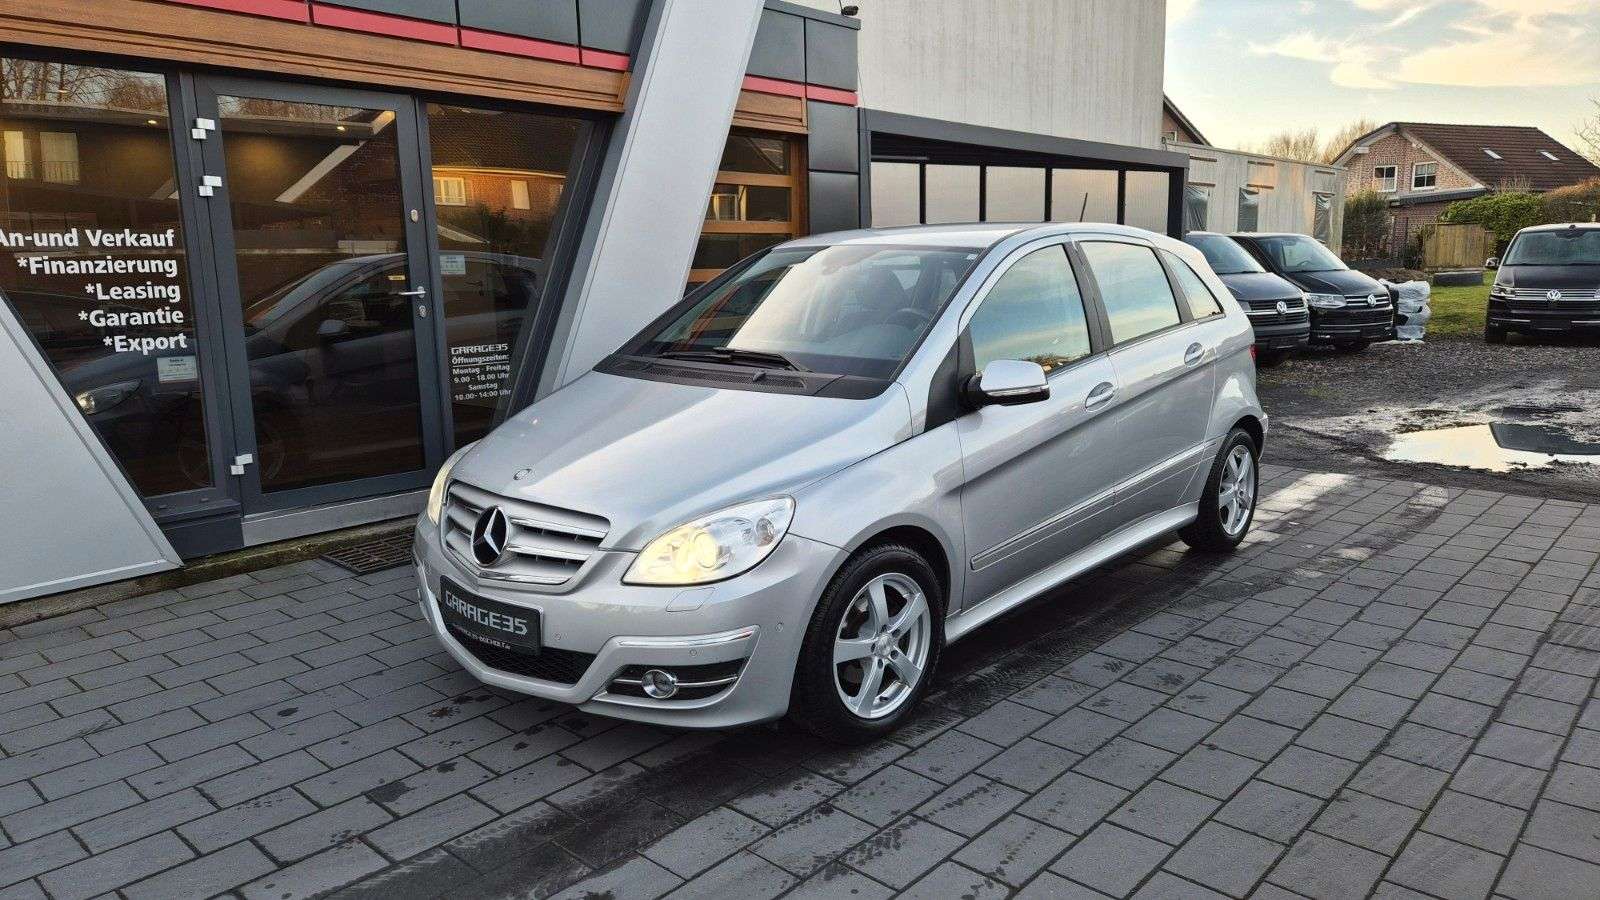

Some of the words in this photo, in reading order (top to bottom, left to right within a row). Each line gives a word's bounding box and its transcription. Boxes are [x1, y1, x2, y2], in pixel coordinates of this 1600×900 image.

[85, 228, 175, 247] Verkauf
[451, 343, 508, 354] GARAGE35
[452, 367, 480, 375] Montag
[468, 383, 498, 391] Samstag
[446, 590, 528, 636] GARAGE35
